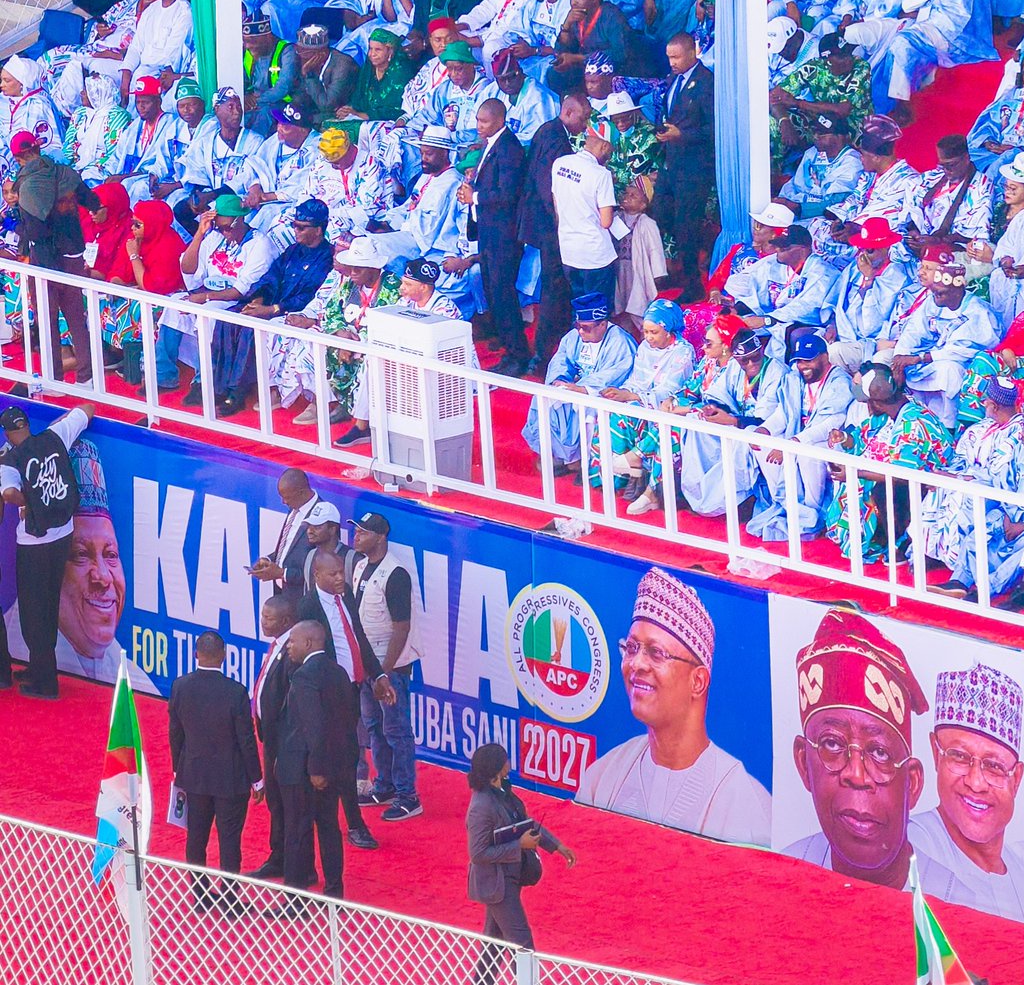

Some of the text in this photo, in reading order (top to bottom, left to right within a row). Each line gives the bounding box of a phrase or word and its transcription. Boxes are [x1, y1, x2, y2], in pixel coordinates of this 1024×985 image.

[26, 453, 59, 488] City
[38, 471, 69, 506] Boy
[133, 476, 519, 710] KANA
[132, 625, 168, 678] FOR
[514, 647, 527, 673] ALL
[582, 616, 602, 694] CONGRESS
[546, 668, 578, 690] APC
[411, 693, 457, 755] UBA
[462, 707, 517, 771] SANI
